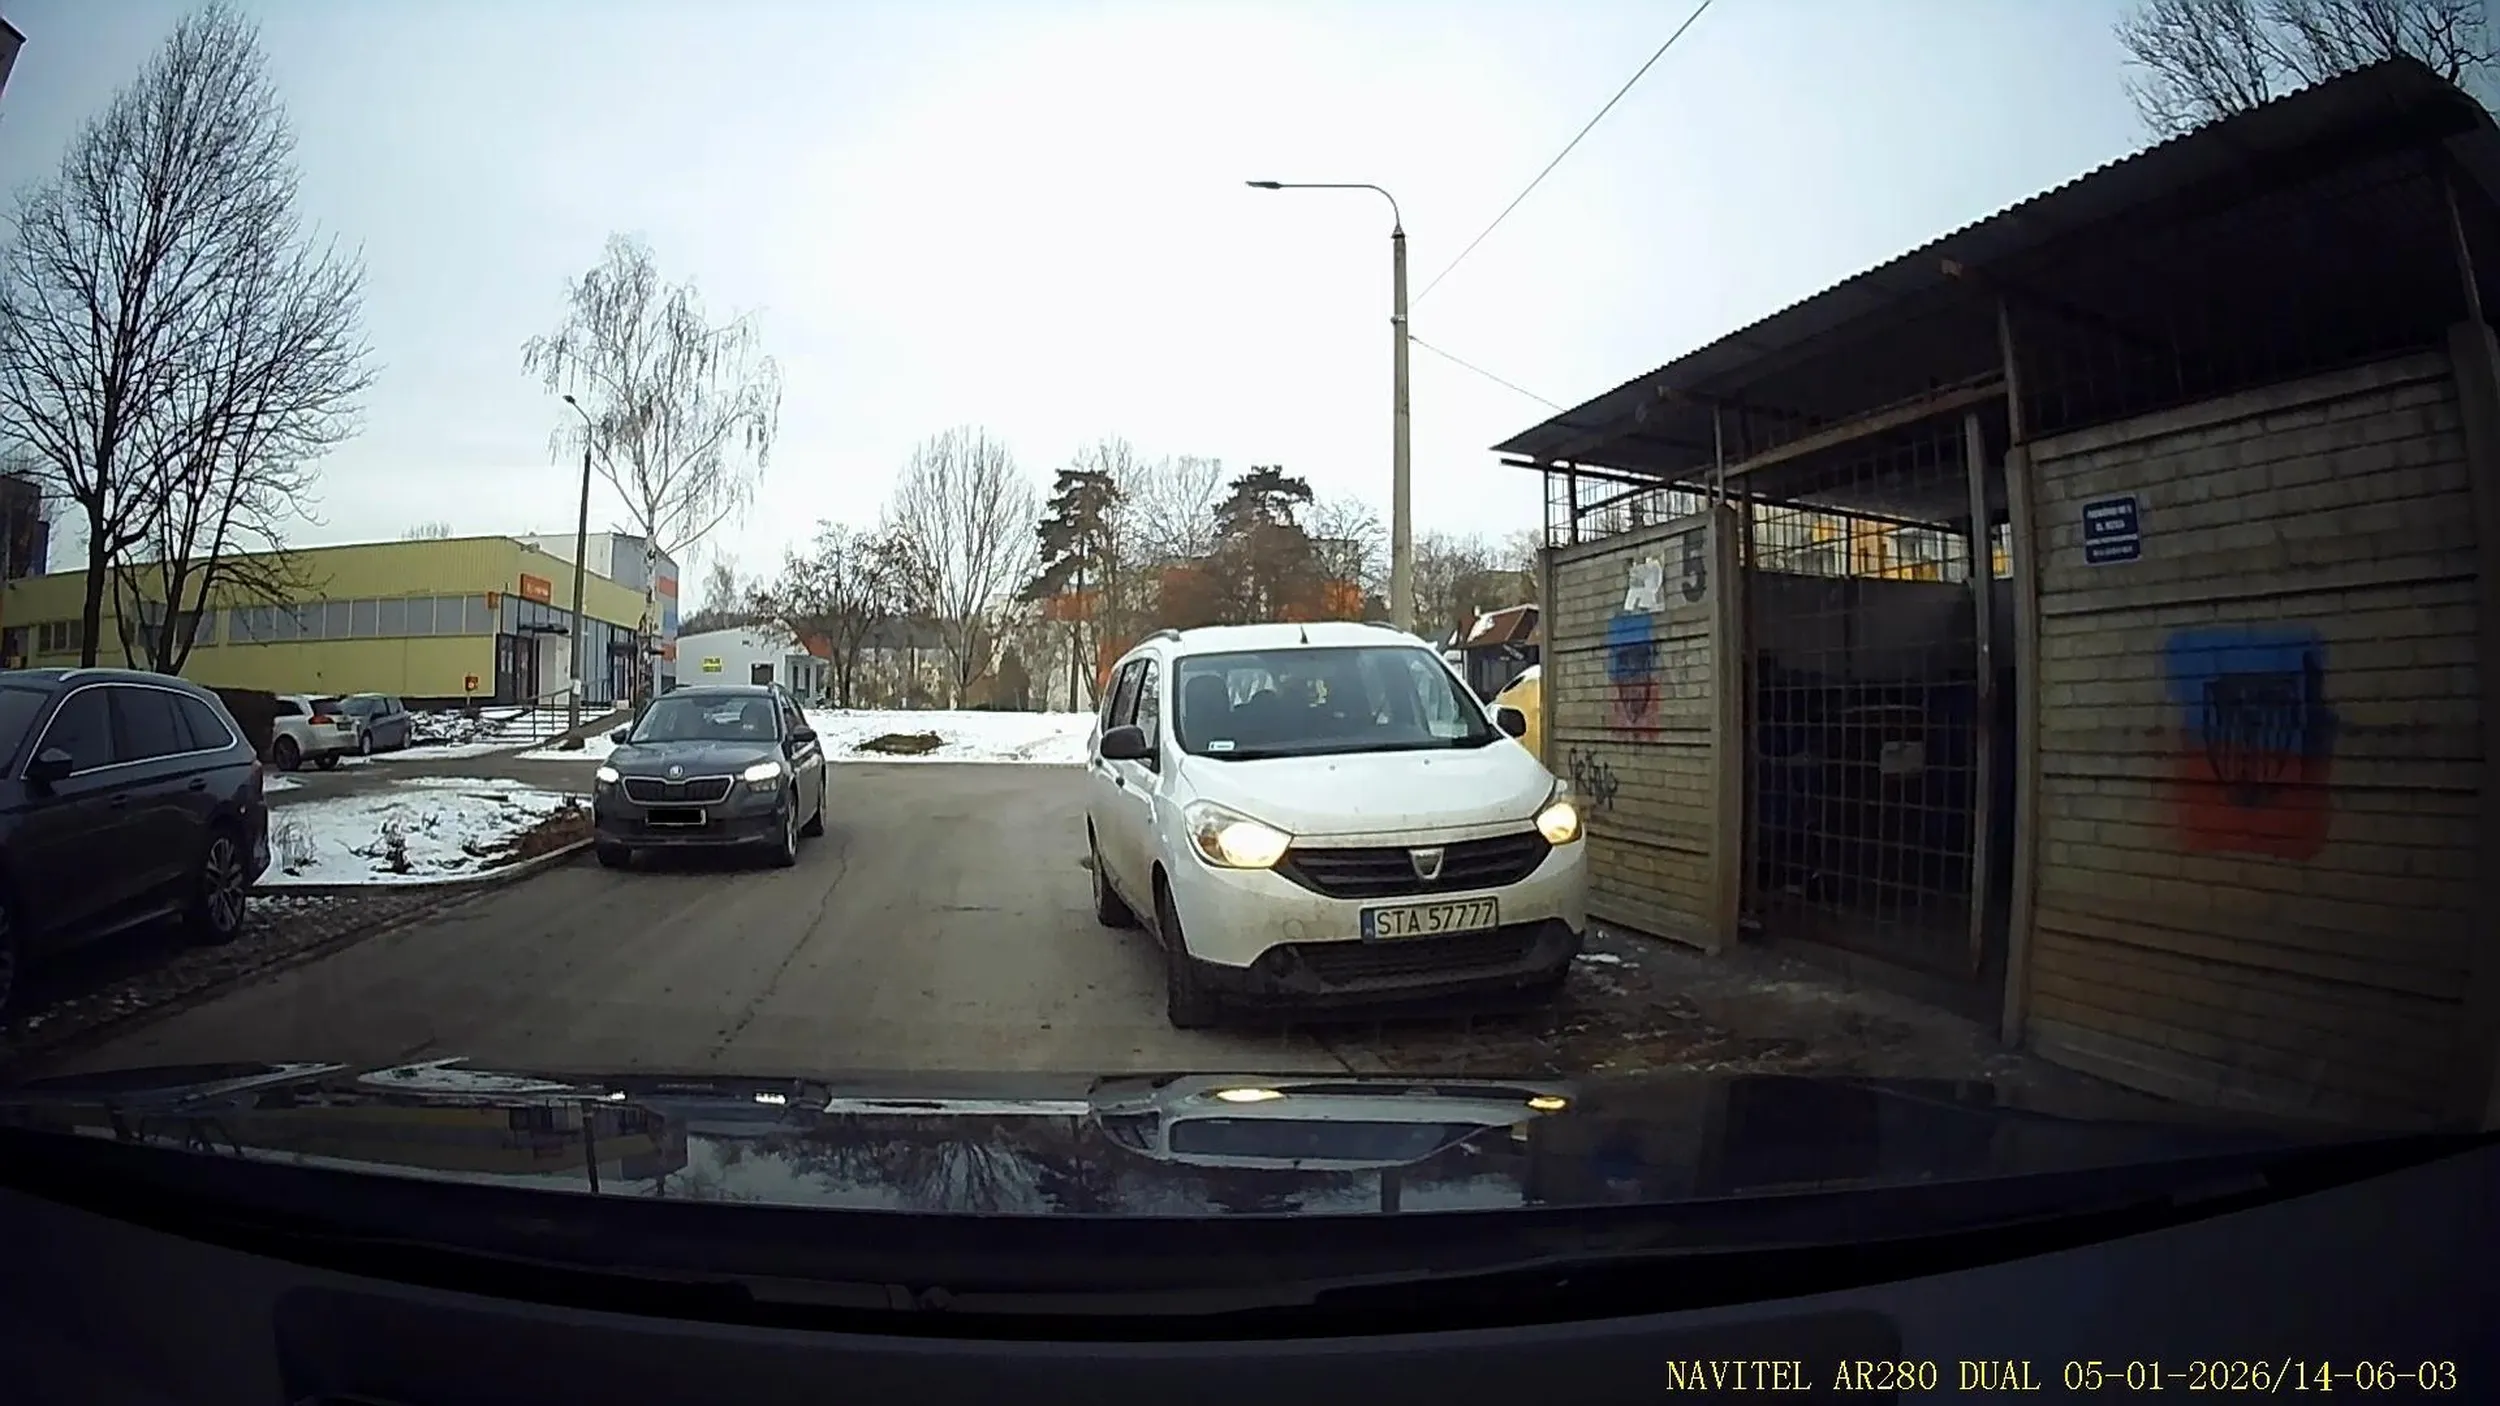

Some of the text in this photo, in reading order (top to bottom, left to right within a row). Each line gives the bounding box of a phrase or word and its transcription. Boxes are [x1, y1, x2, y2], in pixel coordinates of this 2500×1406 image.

[1682, 530, 1706, 603] 5
[1376, 902, 1494, 935] STA 57777
